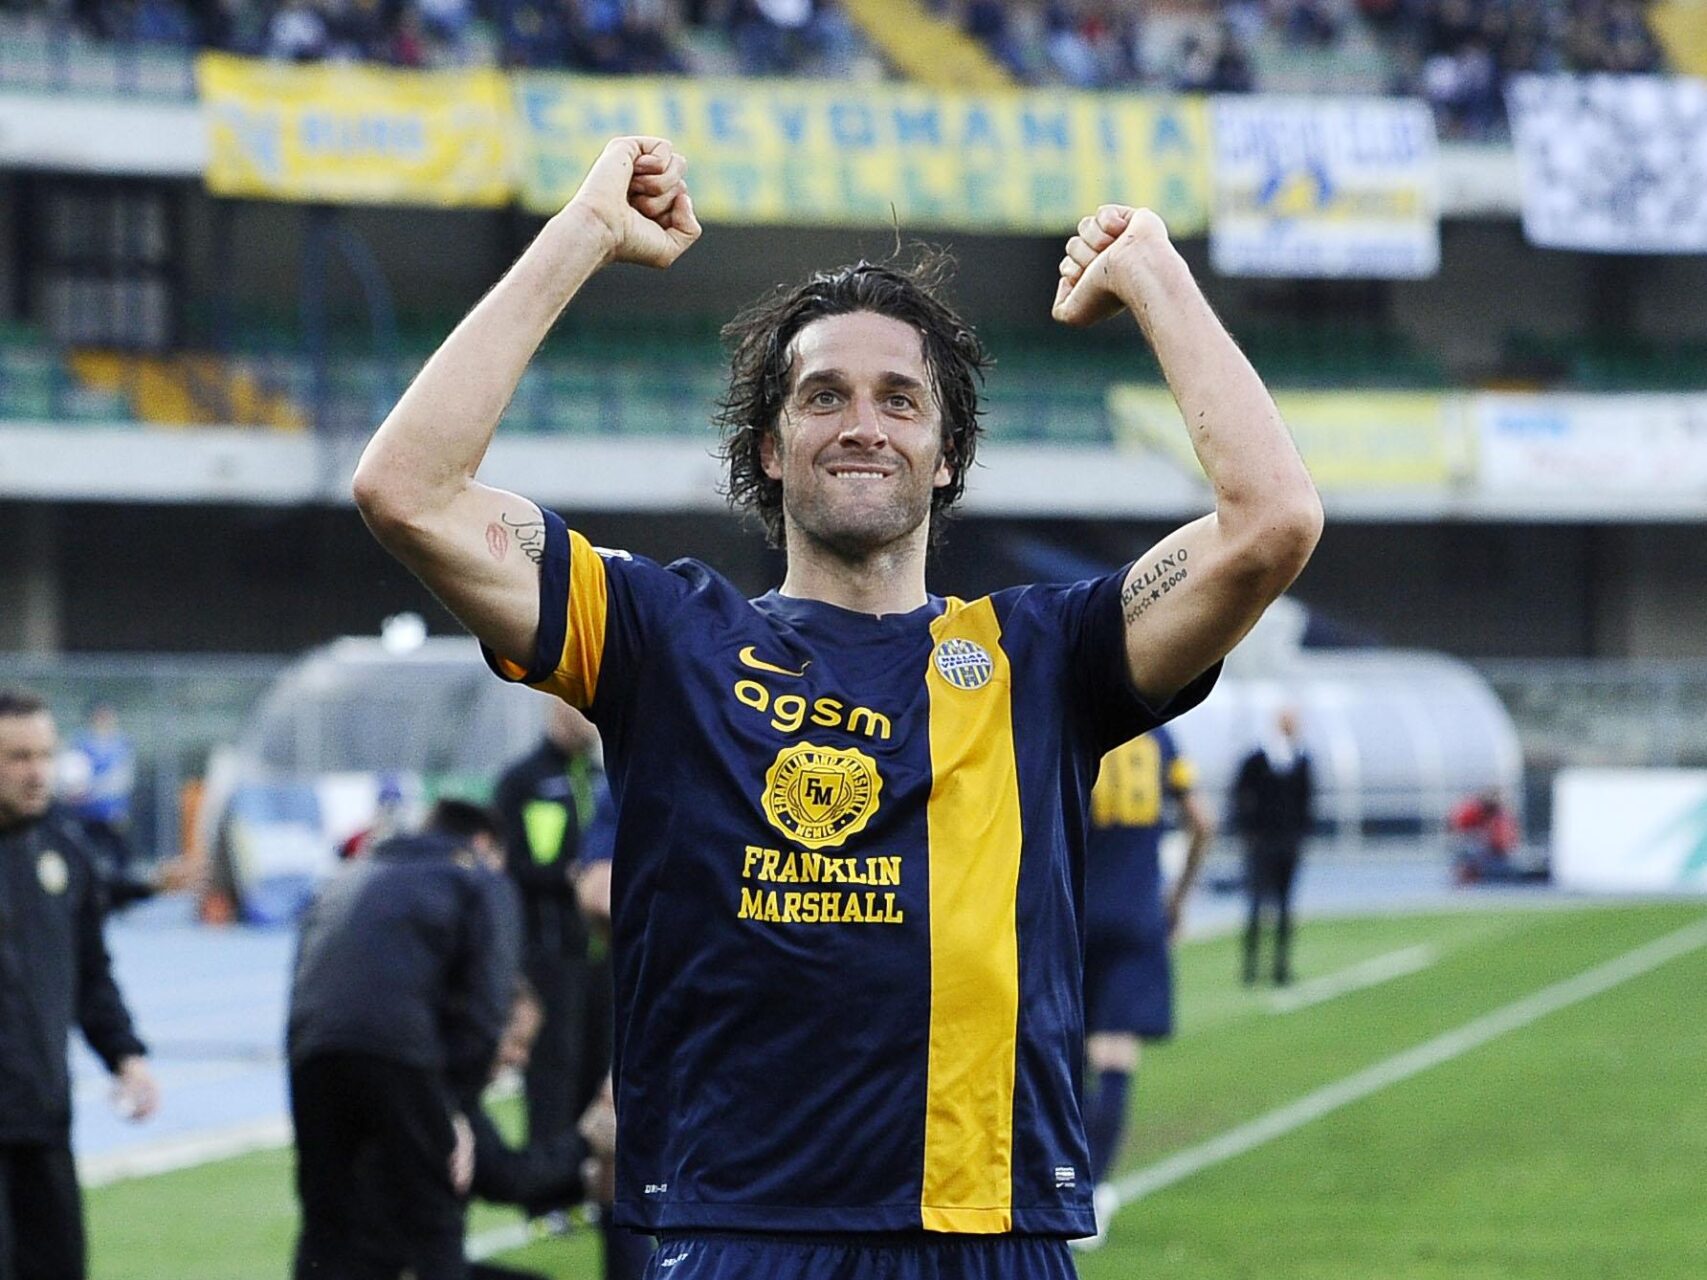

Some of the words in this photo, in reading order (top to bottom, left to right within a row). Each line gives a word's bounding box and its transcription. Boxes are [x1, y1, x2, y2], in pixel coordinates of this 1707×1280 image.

[734, 680, 891, 739] agsm
[742, 845, 902, 885] FRANKLIN
[737, 887, 904, 924] MARSHALL
